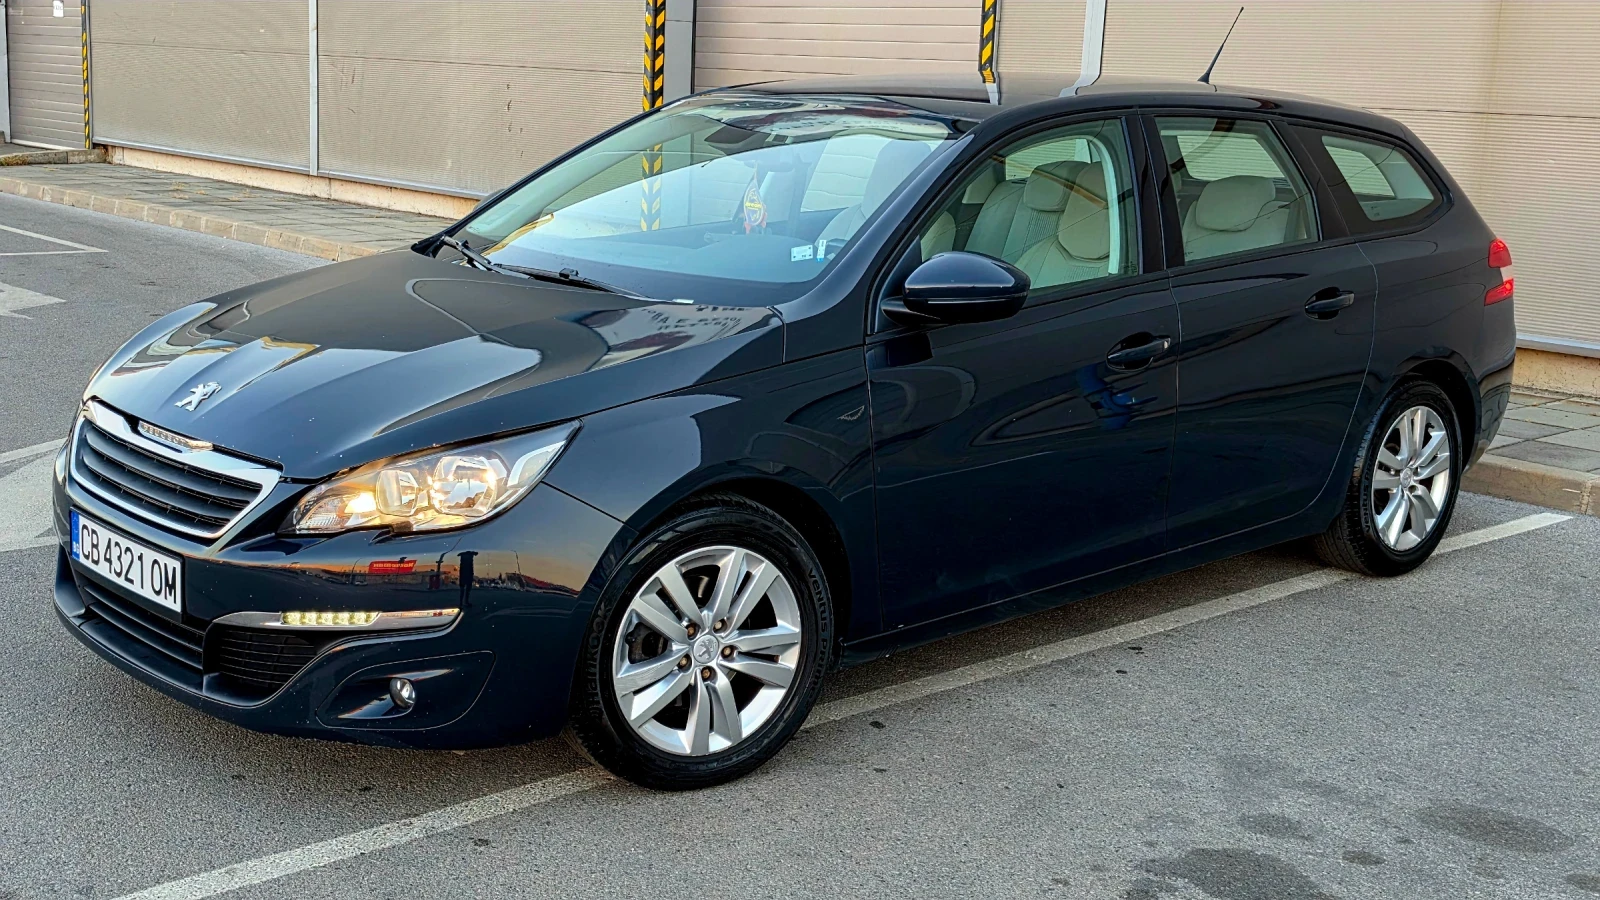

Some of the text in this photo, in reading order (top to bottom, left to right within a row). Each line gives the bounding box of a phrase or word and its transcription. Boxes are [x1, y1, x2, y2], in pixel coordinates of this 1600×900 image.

[81, 523, 177, 605] CB 4321 OM
